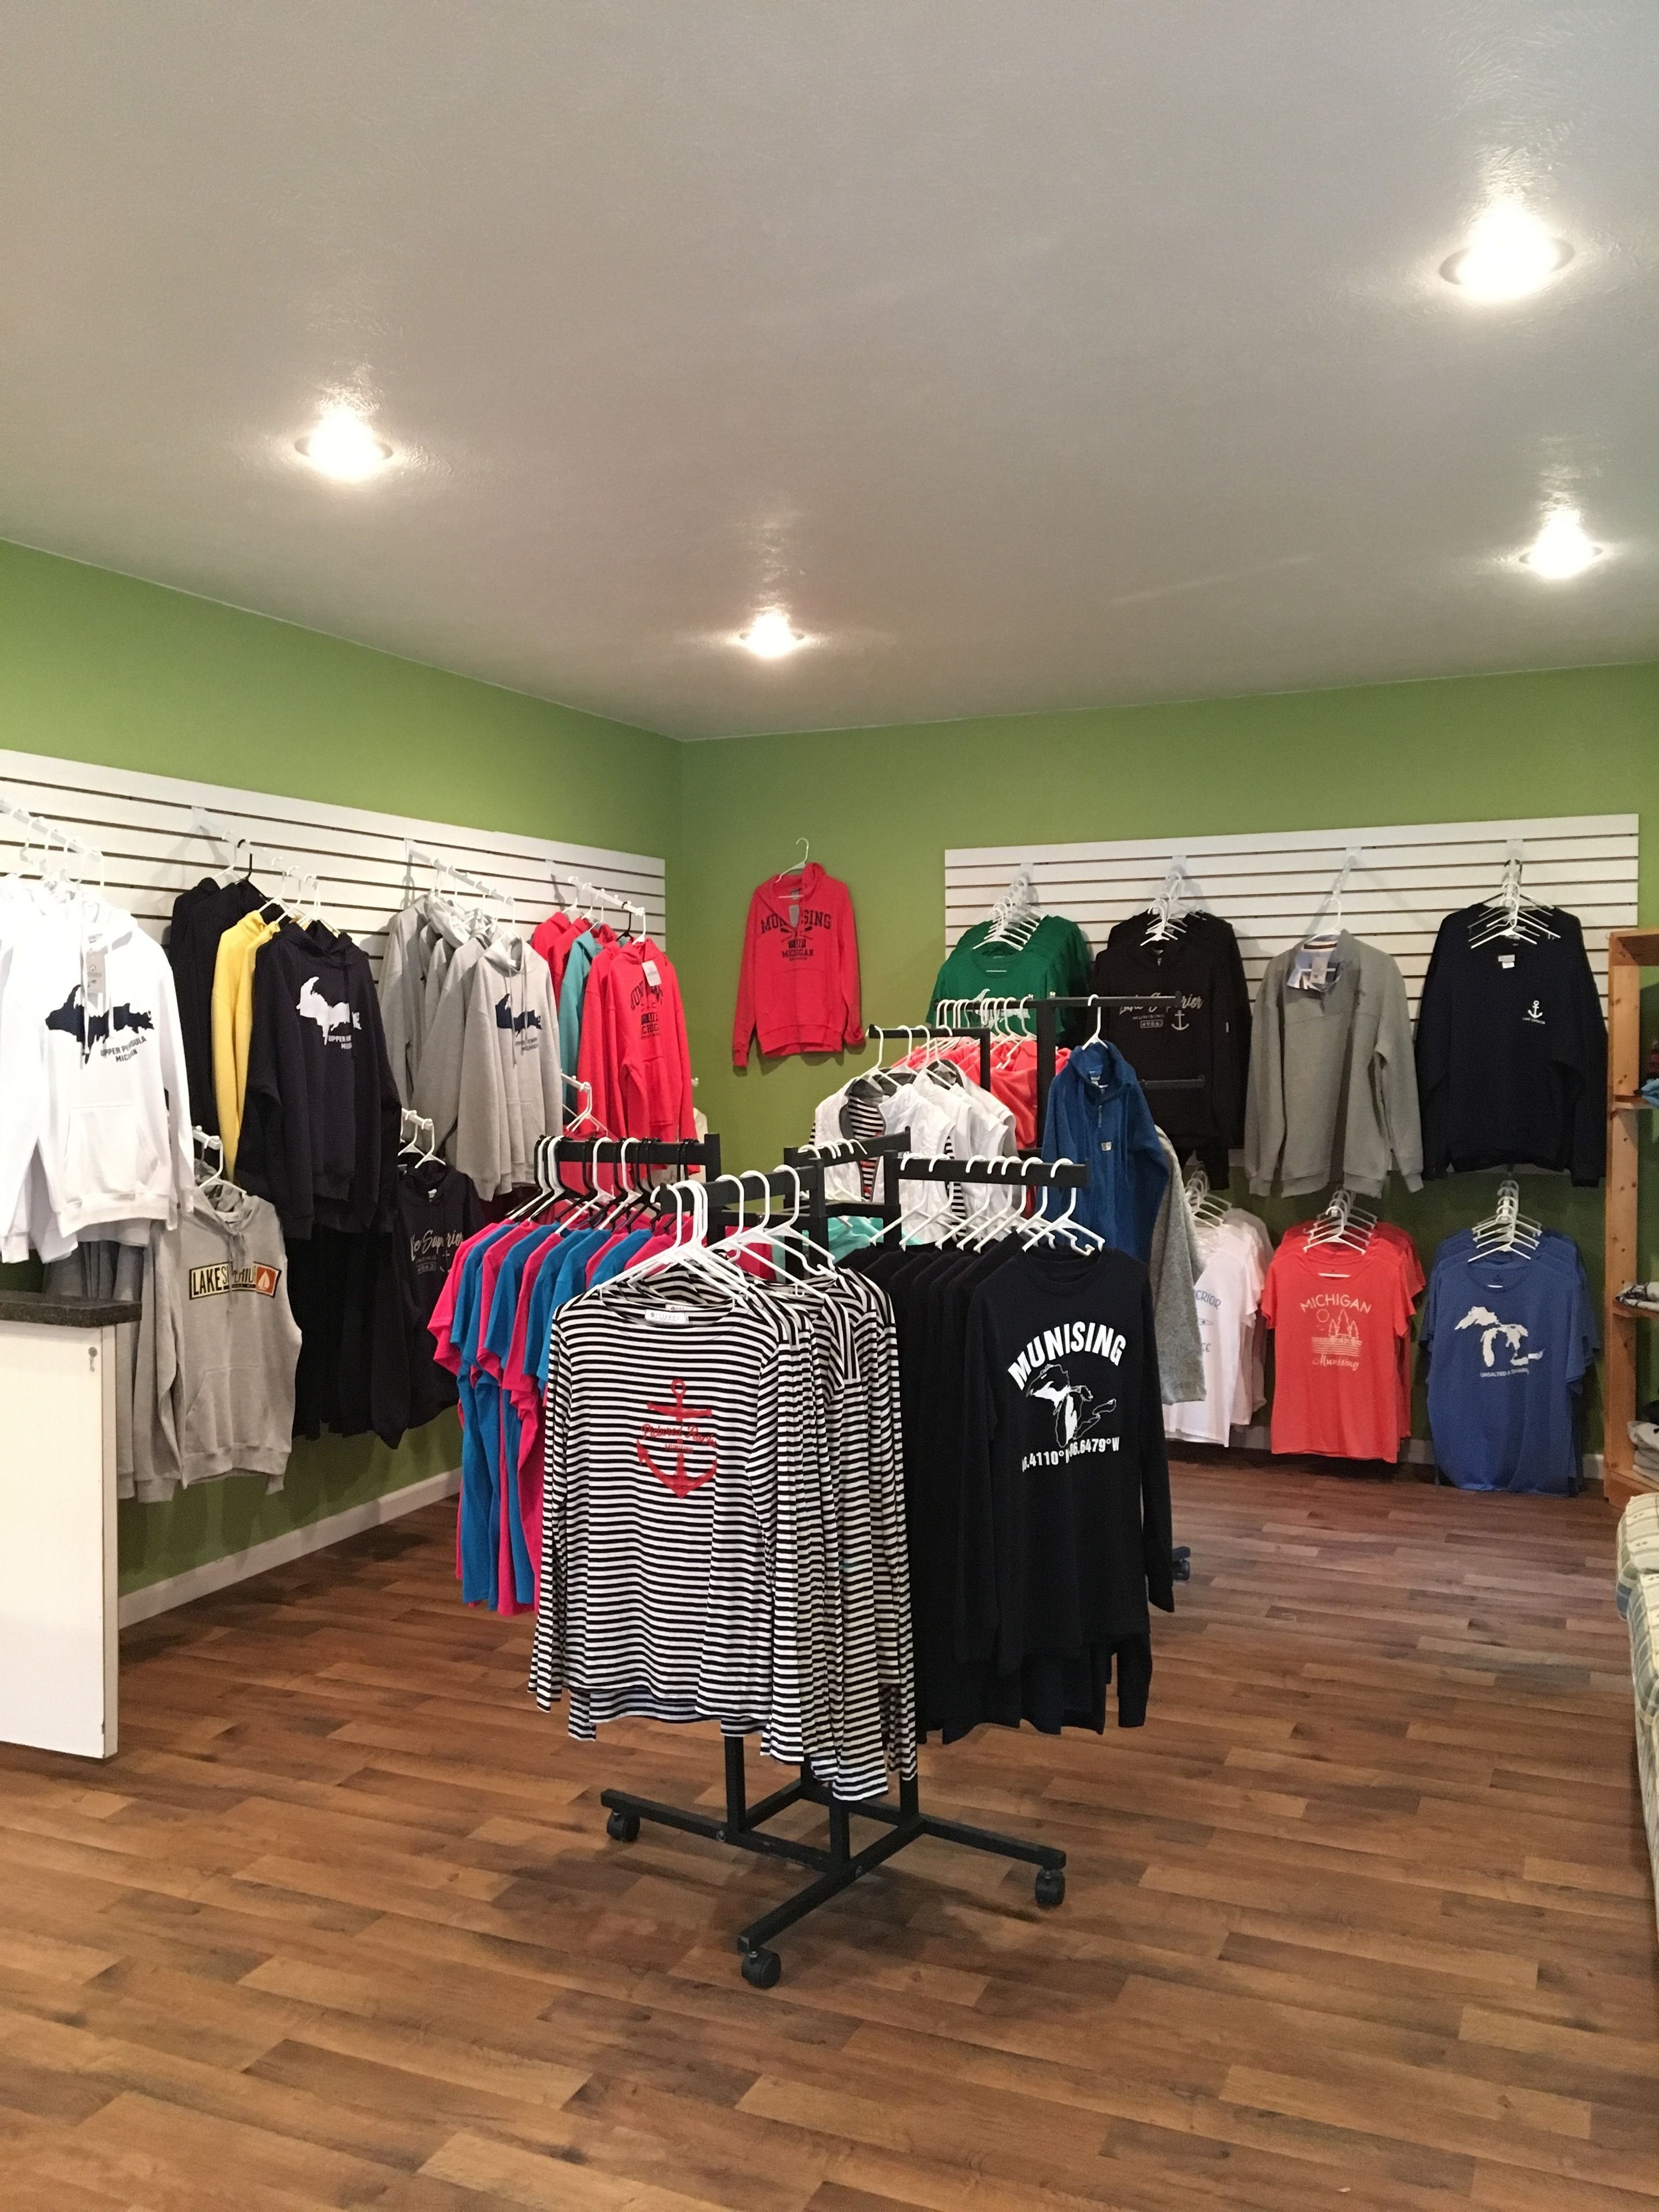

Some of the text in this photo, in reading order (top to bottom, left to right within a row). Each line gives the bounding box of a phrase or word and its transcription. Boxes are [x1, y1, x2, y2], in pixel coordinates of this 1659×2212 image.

[100, 1047, 121, 1056] UPPER
[192, 1267, 222, 1296] LAKE
[1300, 1293, 1372, 1313] MICHIGAN
[1007, 1321, 1126, 1391] MUNISING
[1312, 1354, 1359, 1371] Munising
[641, 1423, 716, 1449] Pictured Rocks
